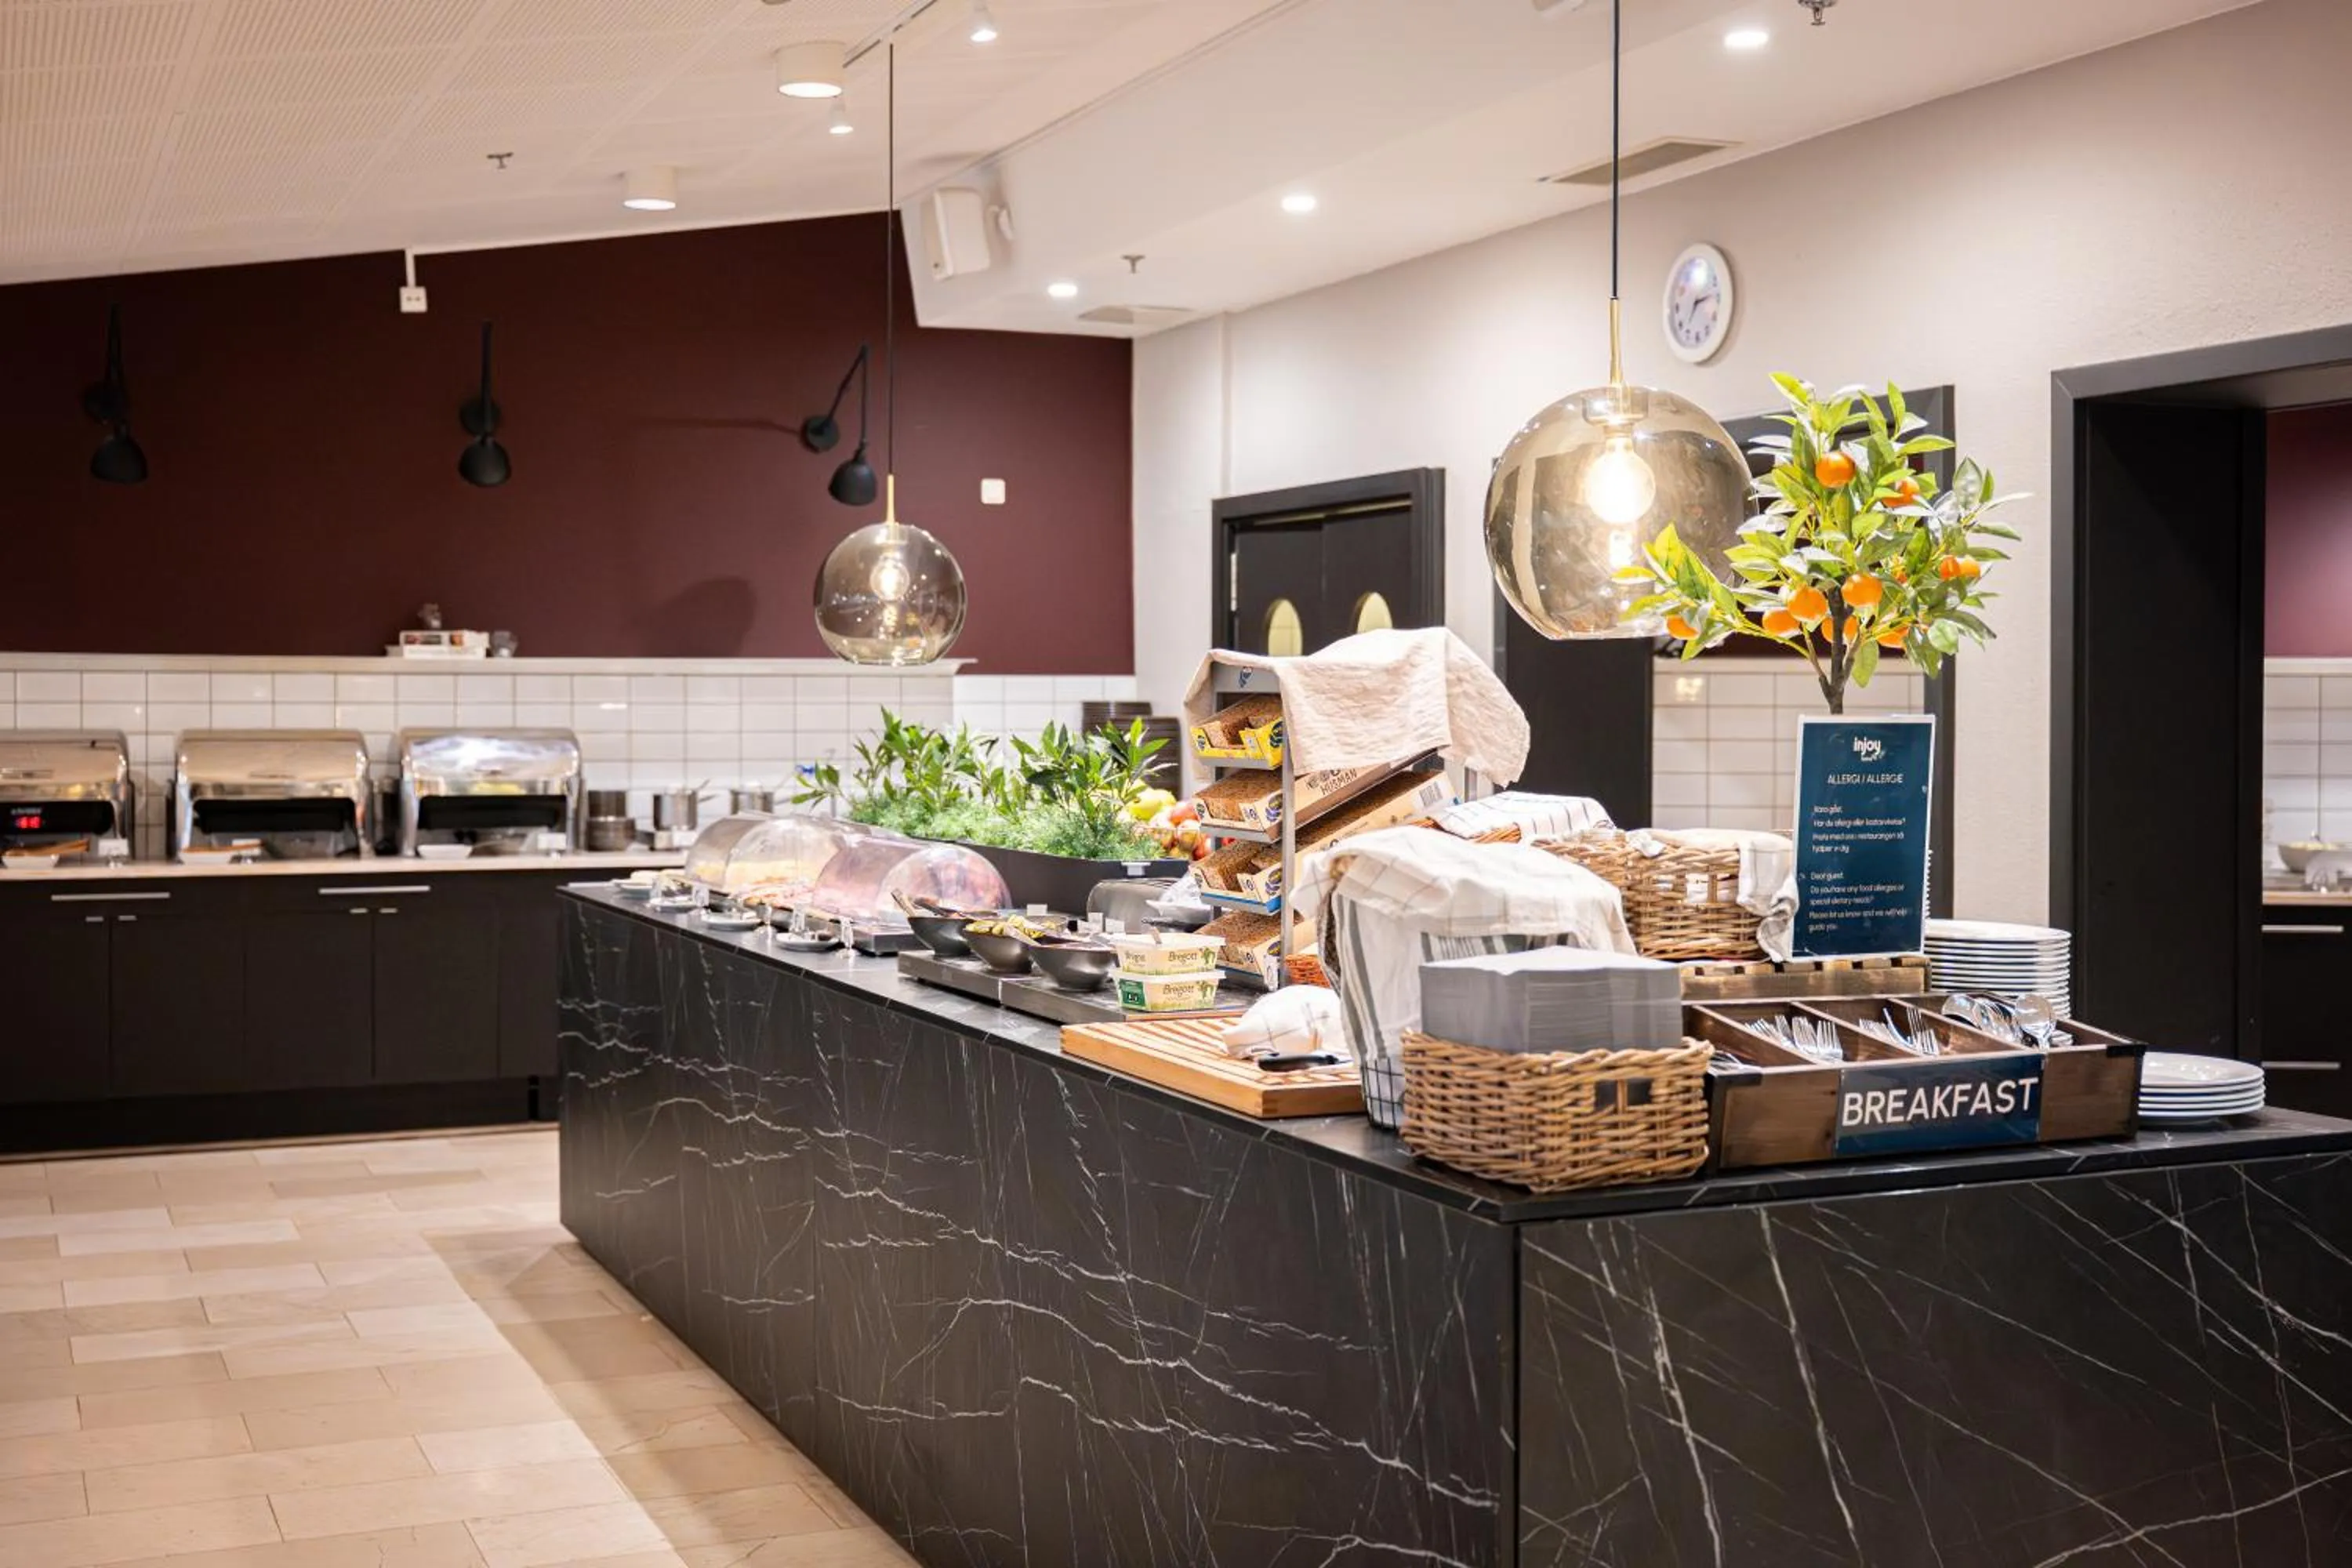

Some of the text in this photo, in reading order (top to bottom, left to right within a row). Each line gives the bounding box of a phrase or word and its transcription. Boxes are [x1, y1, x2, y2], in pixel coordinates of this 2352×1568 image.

[1853, 736, 1881, 755] injoy
[1168, 951, 1197, 964] Bregott
[1163, 984, 1194, 997] Bregott
[1842, 1077, 2038, 1127] BREAKFAST
